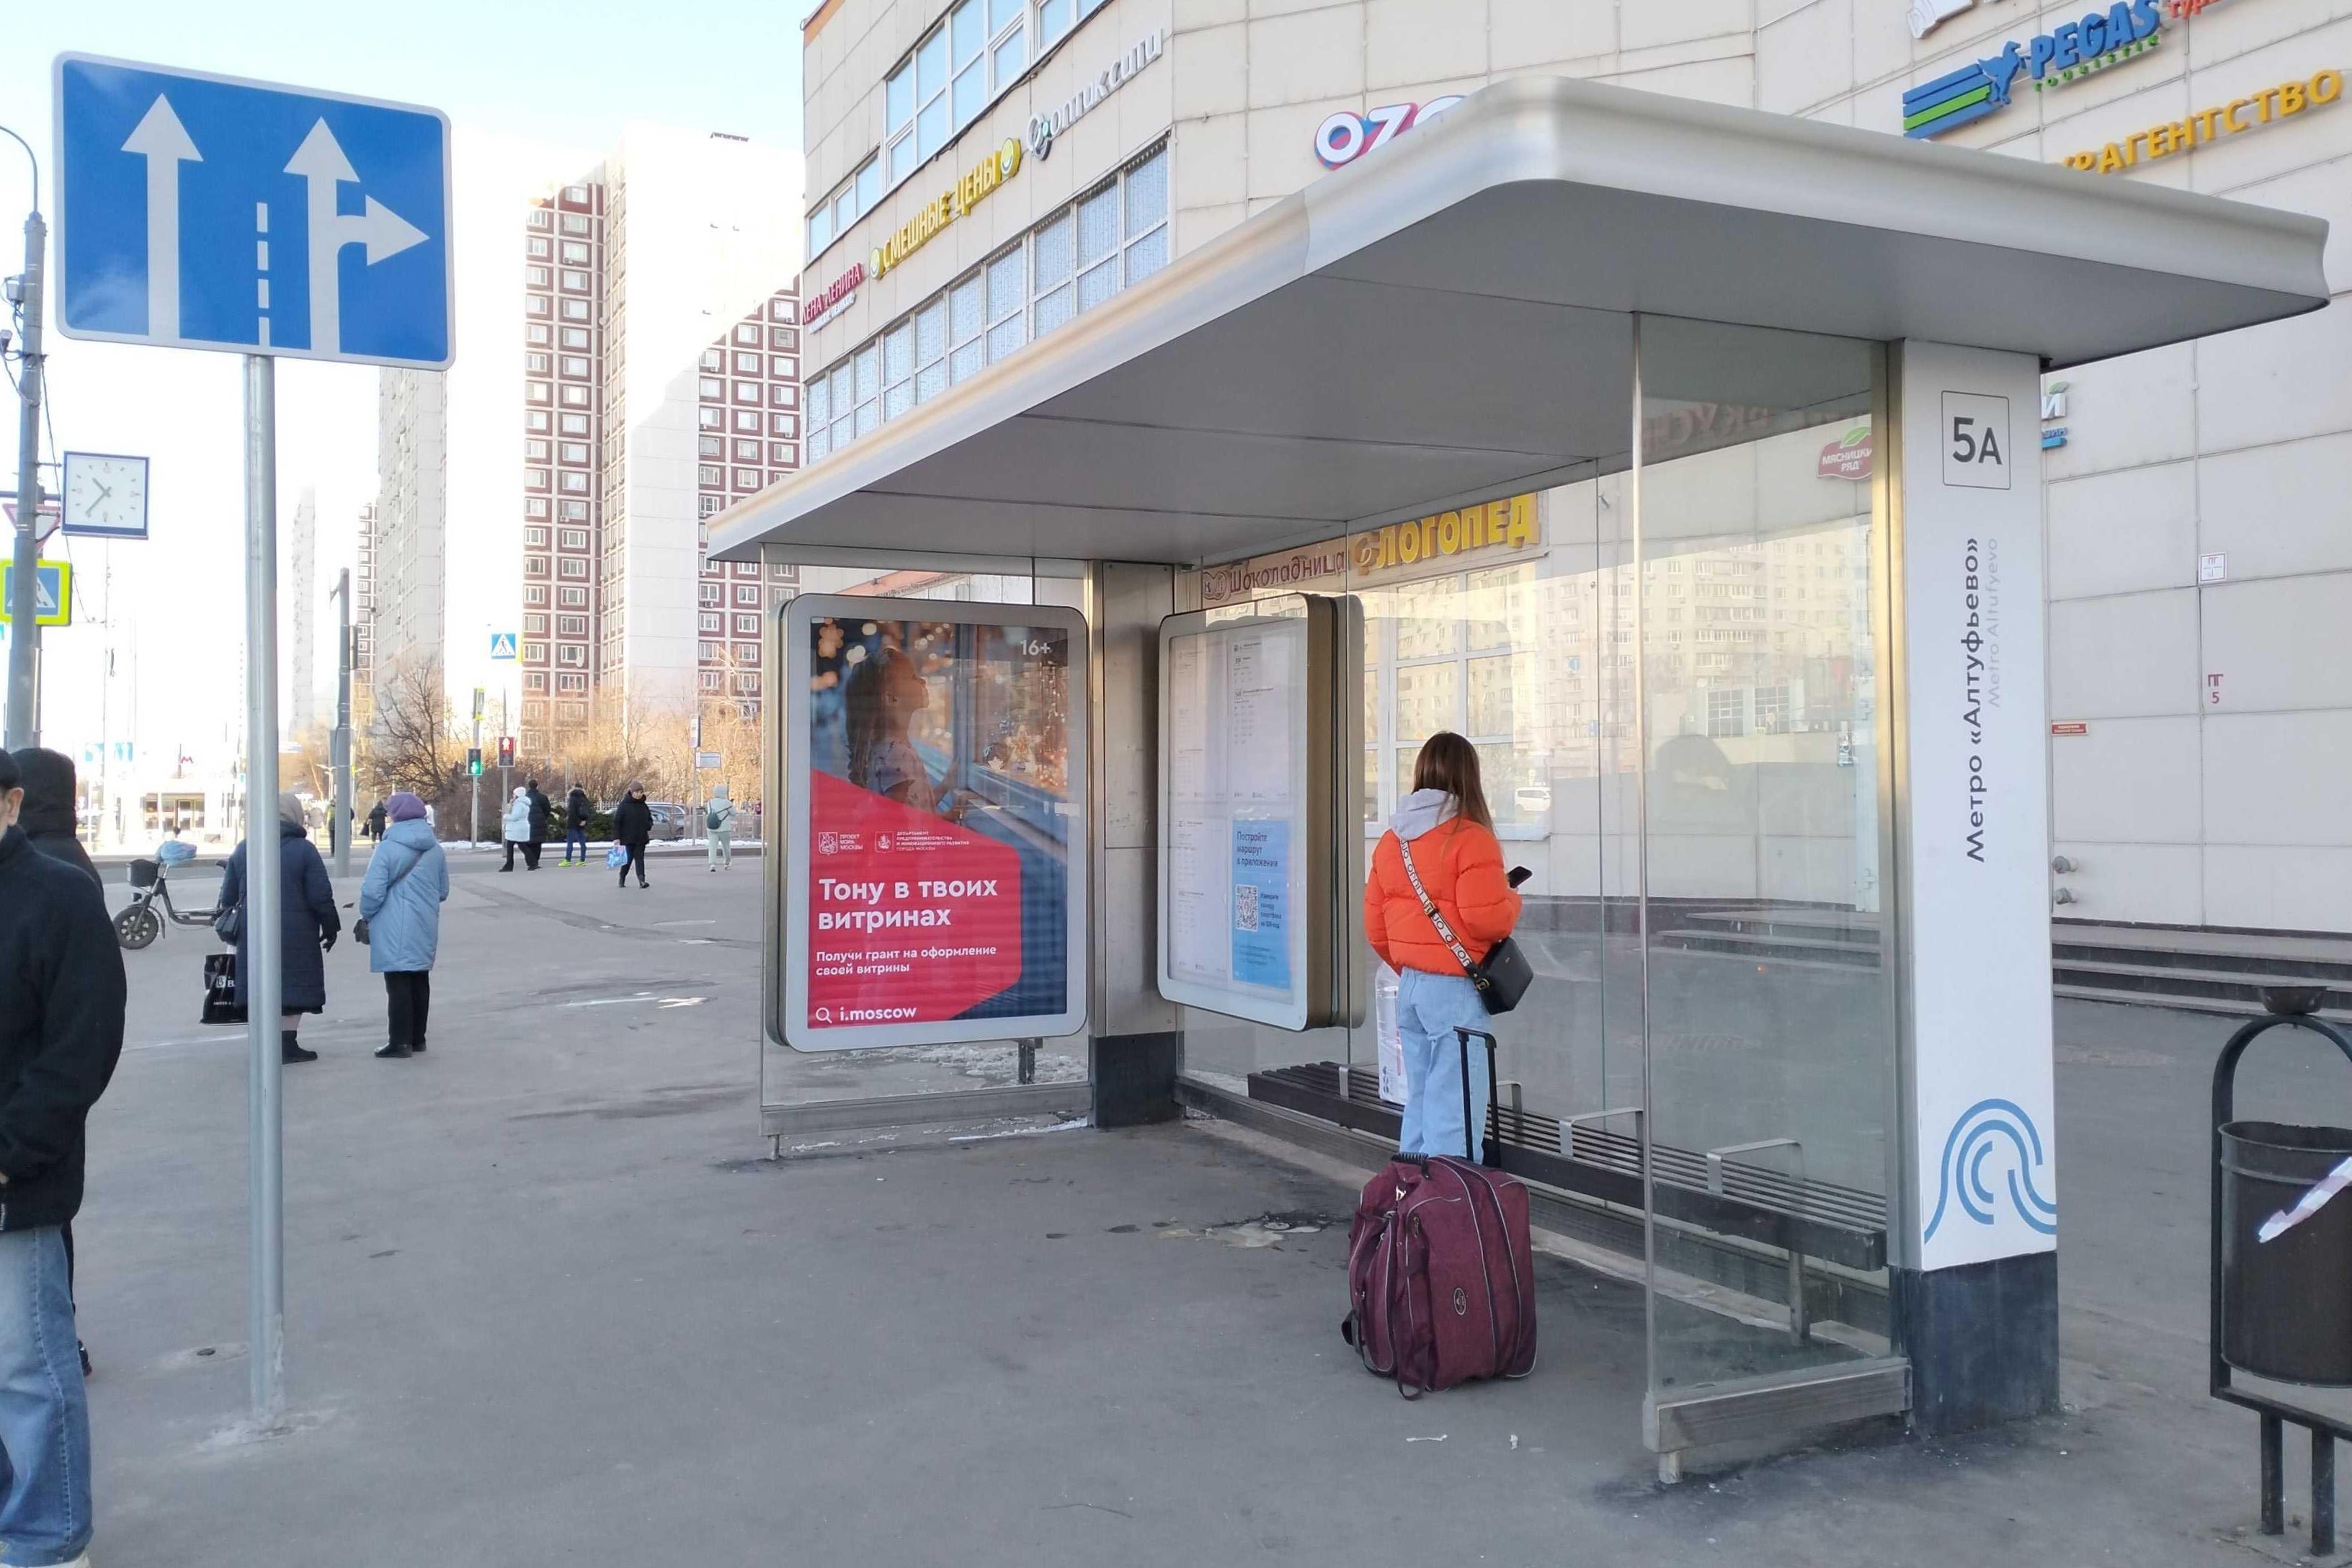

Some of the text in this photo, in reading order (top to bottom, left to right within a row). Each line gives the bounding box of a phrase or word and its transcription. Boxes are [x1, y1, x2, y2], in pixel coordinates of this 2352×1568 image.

[2030, 0, 2160, 79] PEGAS
[2062, 68, 2345, 174] РАГЕНТСТВО
[883, 150, 1002, 270] СМЕШНЫЕ ЦЕНЫ
[1841, 460, 1861, 472] РЯД
[1377, 493, 1541, 569] ЛОГОПЕД
[1229, 551, 1345, 593] Шоколадница
[1984, 538, 2001, 708] Metro Altufyevo
[1020, 639, 1051, 656] 16+
[2207, 674, 2224, 687] ПГ
[1960, 538, 1987, 863] Метро «Алтуфьево»
[2211, 691, 2220, 704] 5
[1237, 831, 1268, 843] Постройте
[1237, 845, 1262, 856] маршрут
[818, 878, 998, 905] Тону в твоих
[818, 908, 952, 934] витринах
[816, 946, 997, 964] Получи грант на оформление
[815, 963, 910, 976] своей витрины
[839, 1006, 917, 1022] i.moscow
